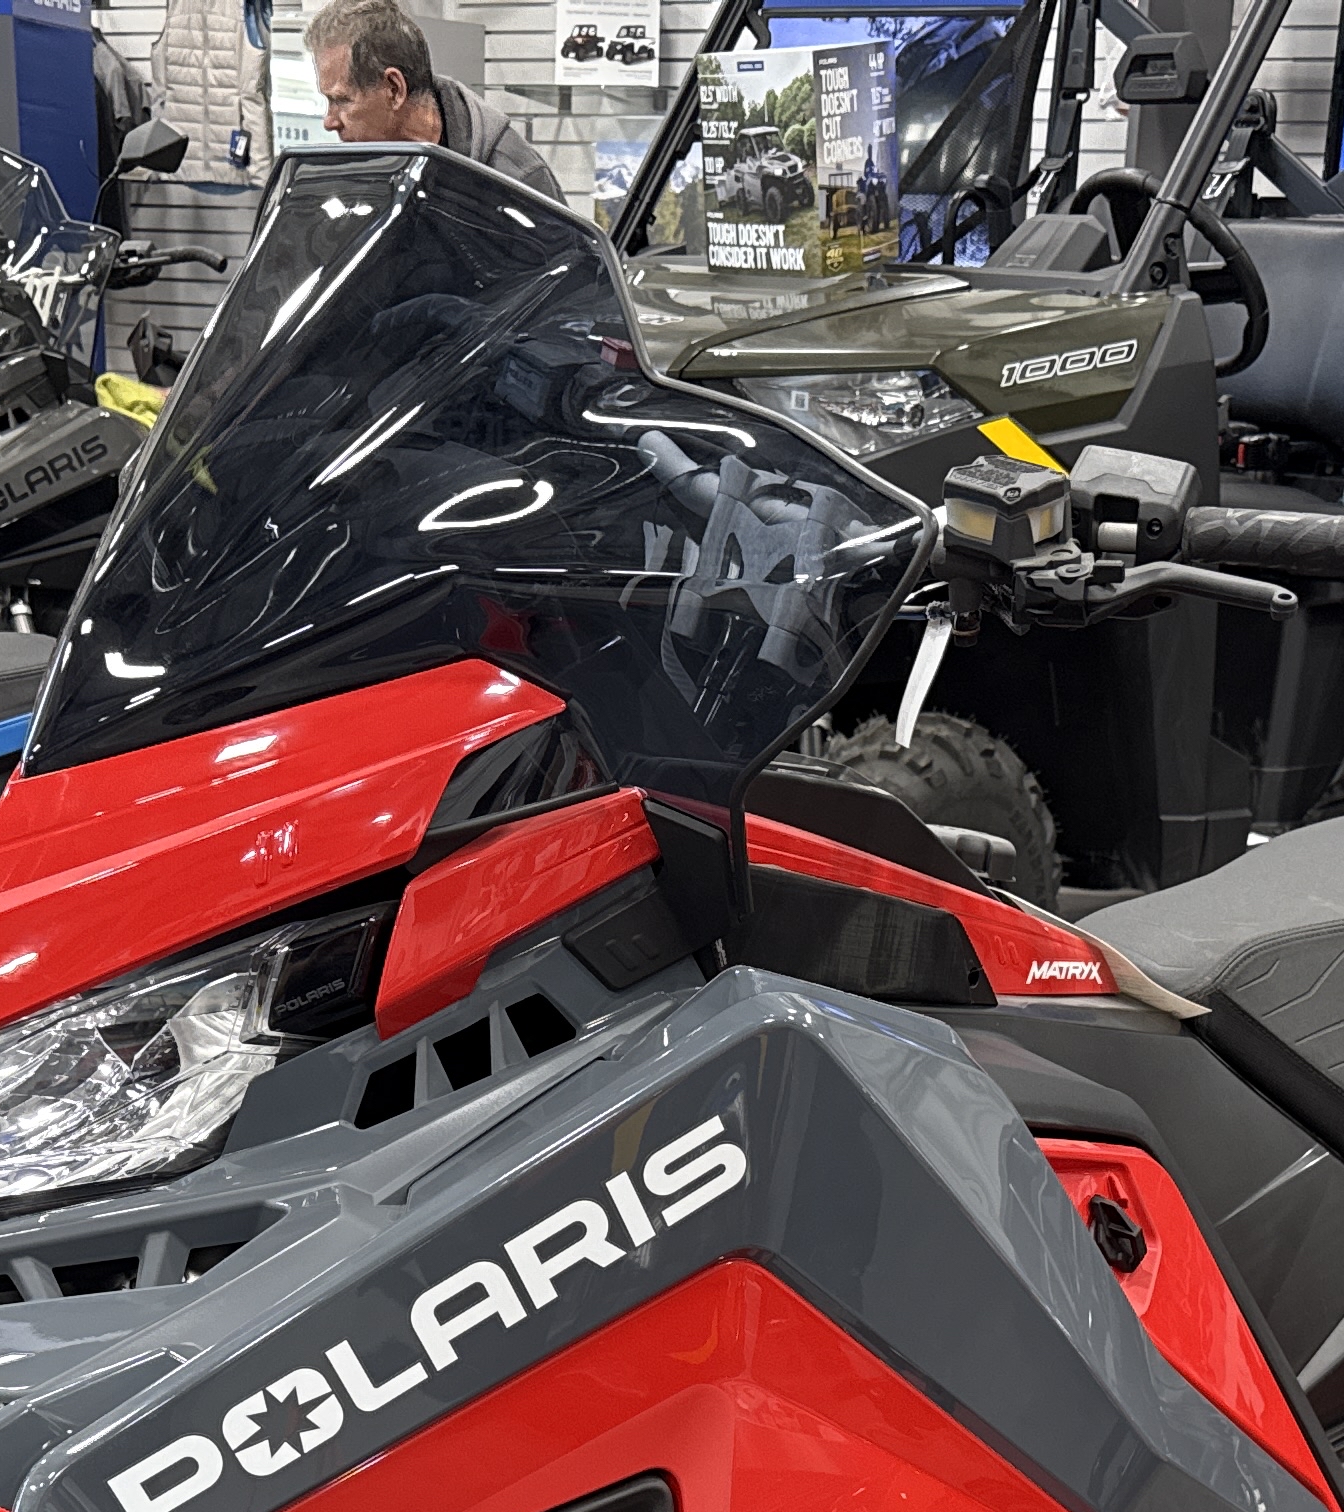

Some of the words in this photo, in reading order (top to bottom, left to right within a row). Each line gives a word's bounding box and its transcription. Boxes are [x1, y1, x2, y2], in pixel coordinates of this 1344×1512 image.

[820, 66, 849, 92] TOUGH
[821, 89, 857, 117] DOESN'T
[822, 116, 841, 140] CUT
[823, 136, 863, 164] CORNERS
[708, 222, 737, 246] TOUGH
[738, 223, 785, 247] DOESN'T
[709, 246, 755, 269] CONSIDER
[757, 247, 767, 269] IT
[769, 247, 805, 270] WORK
[1000, 338, 1137, 388] 1000
[1025, 960, 1103, 985] MATRYX
[274, 977, 346, 1017] POLARIS
